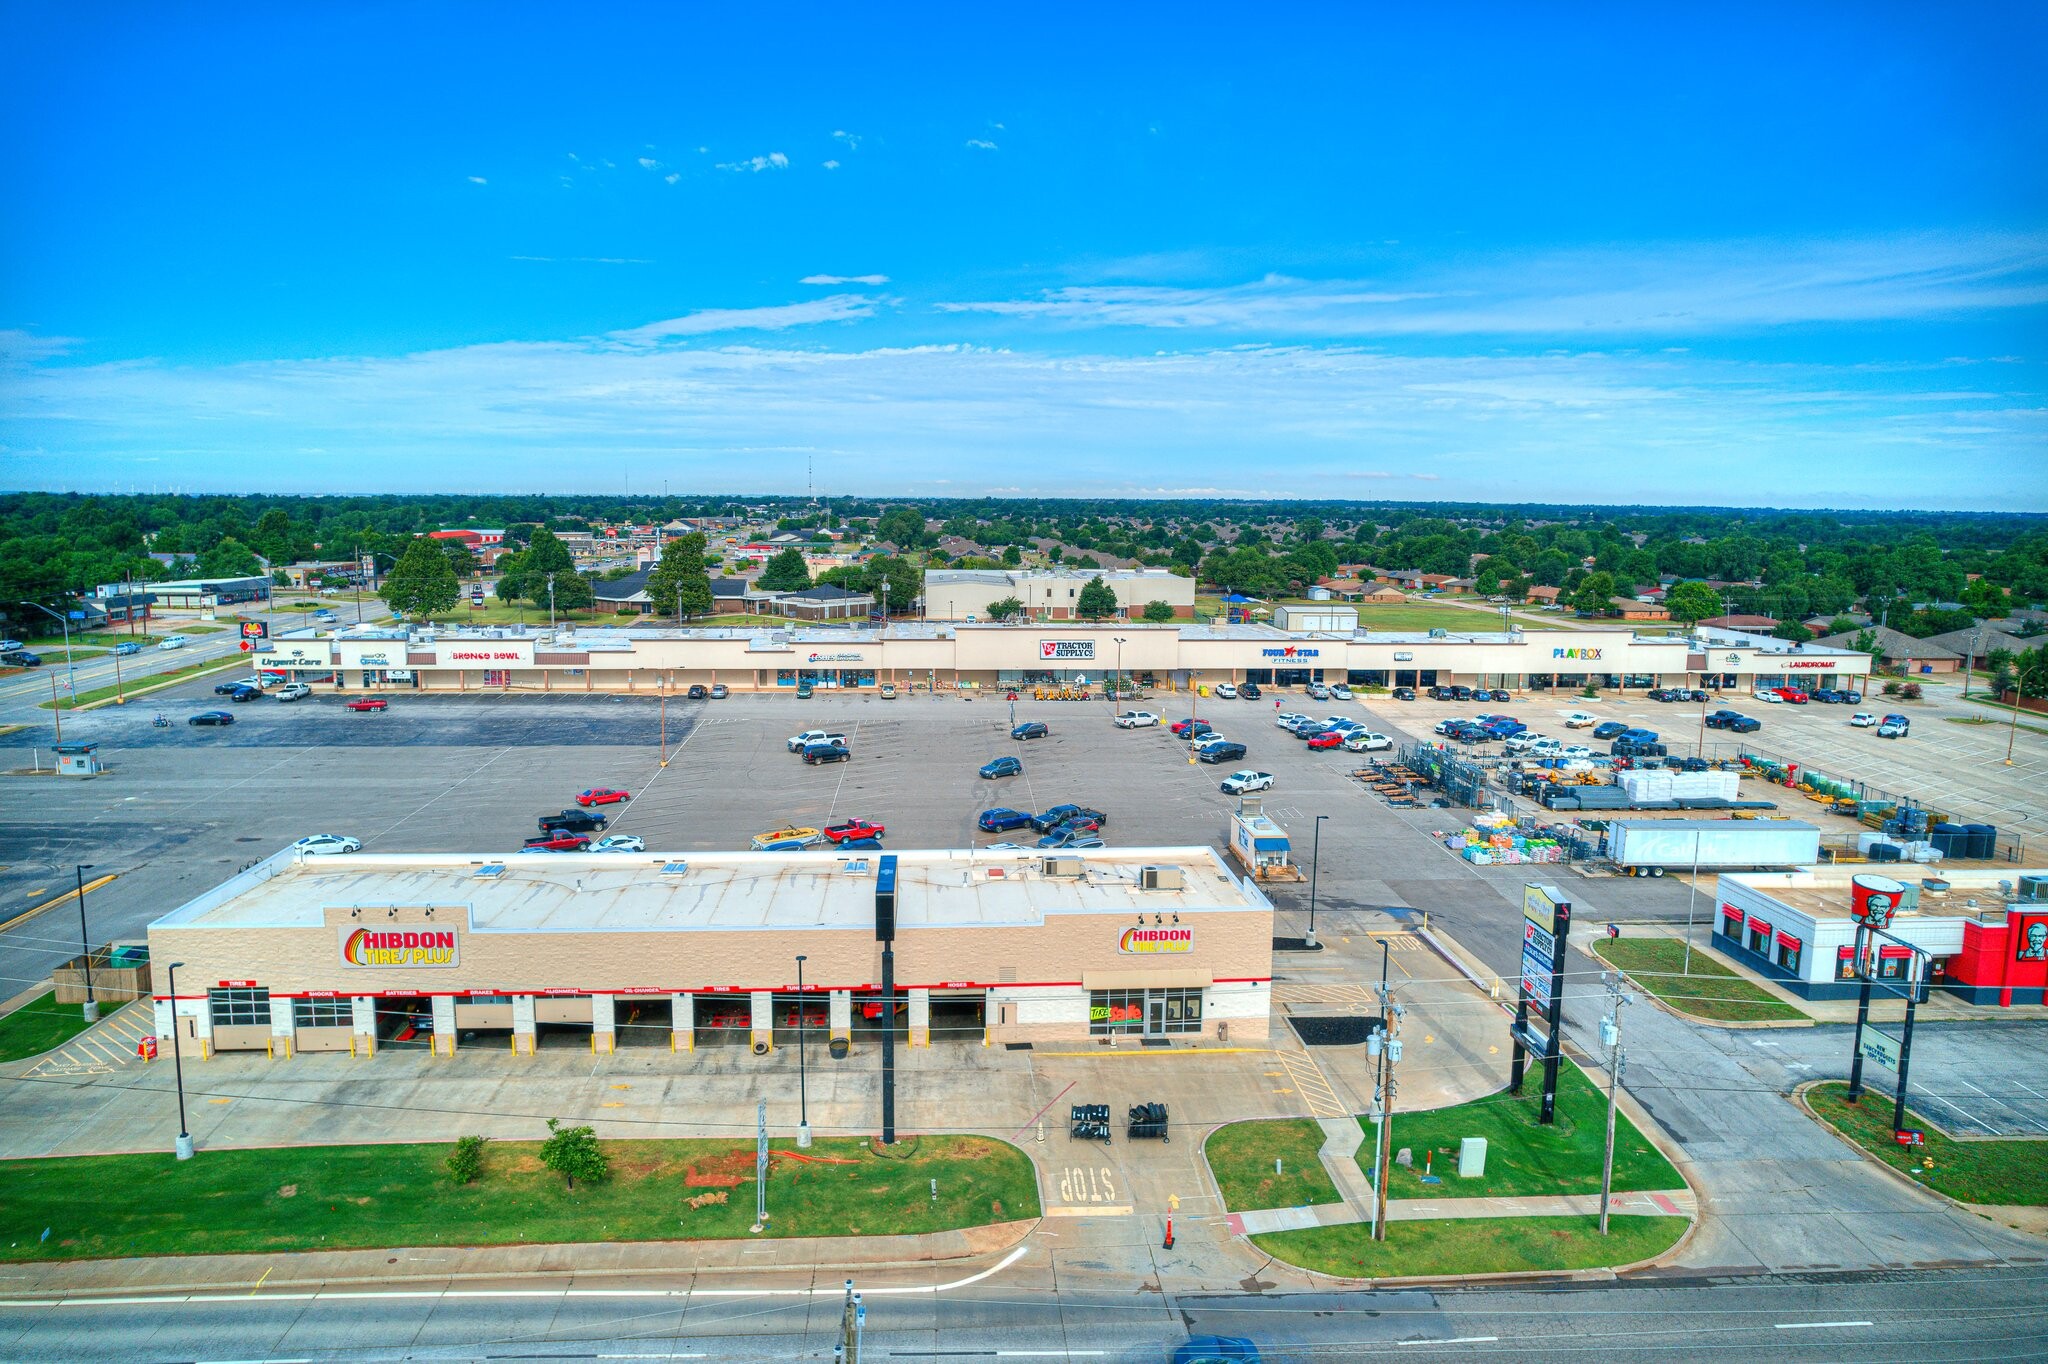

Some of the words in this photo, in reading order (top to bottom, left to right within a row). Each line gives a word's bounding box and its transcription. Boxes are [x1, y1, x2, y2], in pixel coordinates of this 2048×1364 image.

[452, 652, 491, 660] BRONCO
[493, 652, 520, 660] BOWL
[1262, 649, 1286, 657] FOUR
[1297, 649, 1319, 657] STAR
[1552, 648, 1602, 660] PLAYBOX
[261, 658, 297, 667] Urgent
[298, 658, 322, 666] Care
[363, 932, 454, 949] HIBDON
[1133, 930, 1191, 941] HIBDON
[1133, 941, 1162, 952] TIRES
[1163, 941, 1191, 952] PLUS
[364, 948, 410, 964] TIRES
[413, 948, 454, 964] PLUS
[1061, 1167, 1116, 1202] STOP
